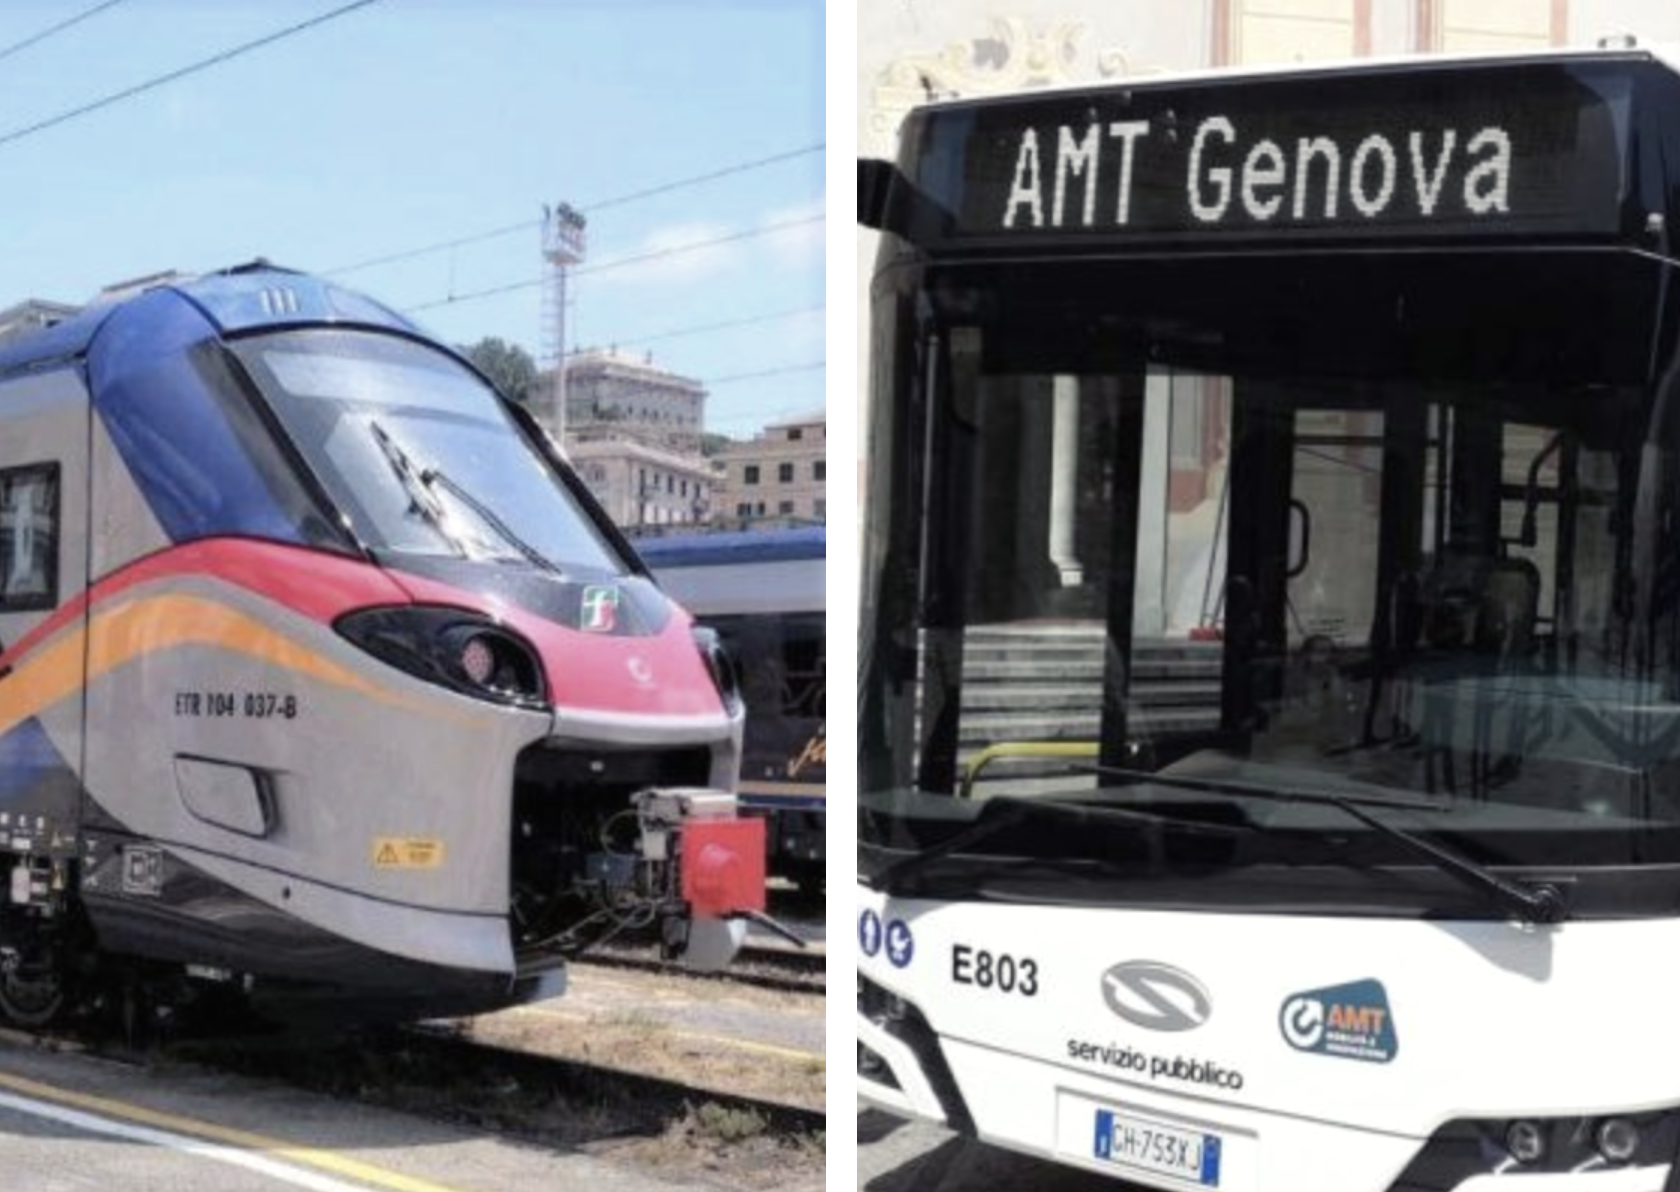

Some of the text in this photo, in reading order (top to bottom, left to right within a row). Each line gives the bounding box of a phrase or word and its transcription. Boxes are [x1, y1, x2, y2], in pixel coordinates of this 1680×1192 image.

[1003, 115, 1511, 227] AMT Genova
[207, 692, 234, 717] 104
[952, 943, 1038, 997] E803
[1326, 1003, 1387, 1036] AMT
[1067, 1038, 1244, 1090] servizio pubblico
